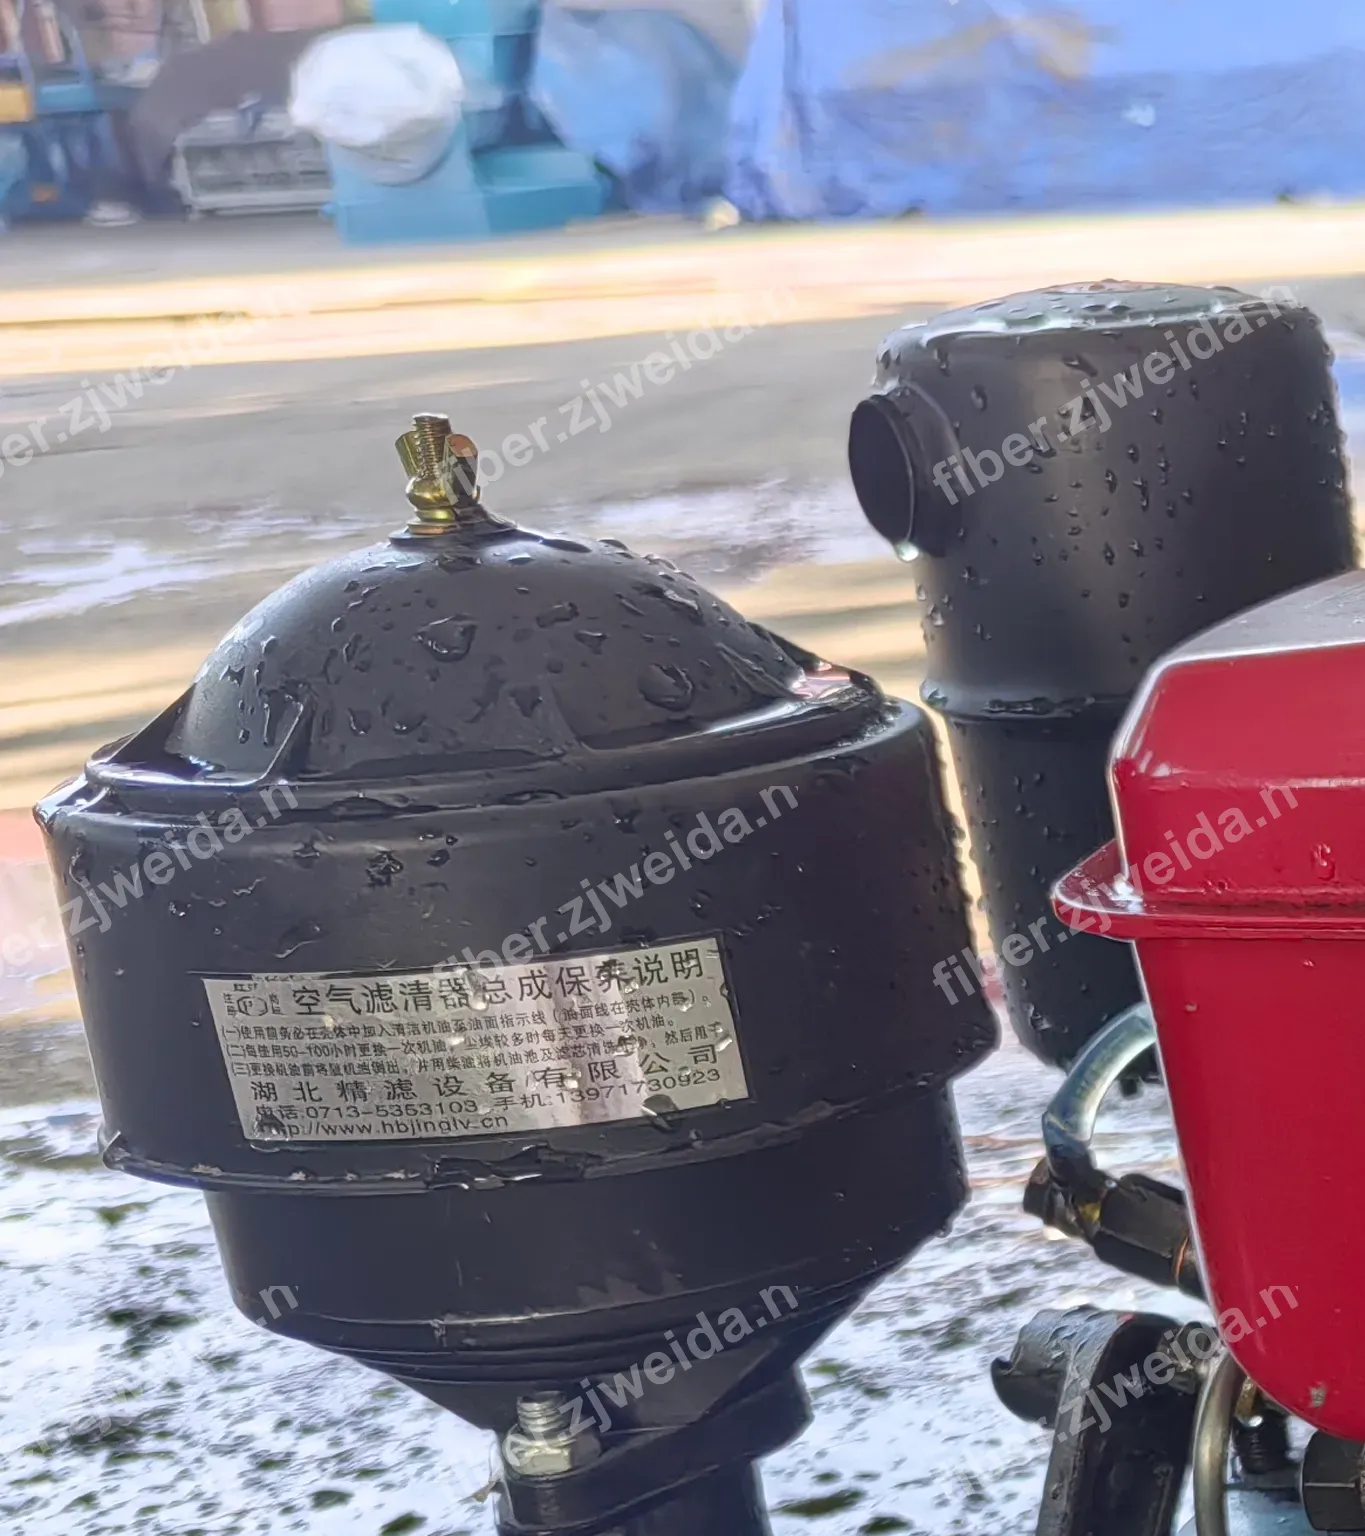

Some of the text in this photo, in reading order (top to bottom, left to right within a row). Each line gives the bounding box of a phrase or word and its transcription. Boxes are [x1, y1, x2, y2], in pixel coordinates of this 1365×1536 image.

[251, 1044, 719, 1103] 湖北精滤设备有限公司
